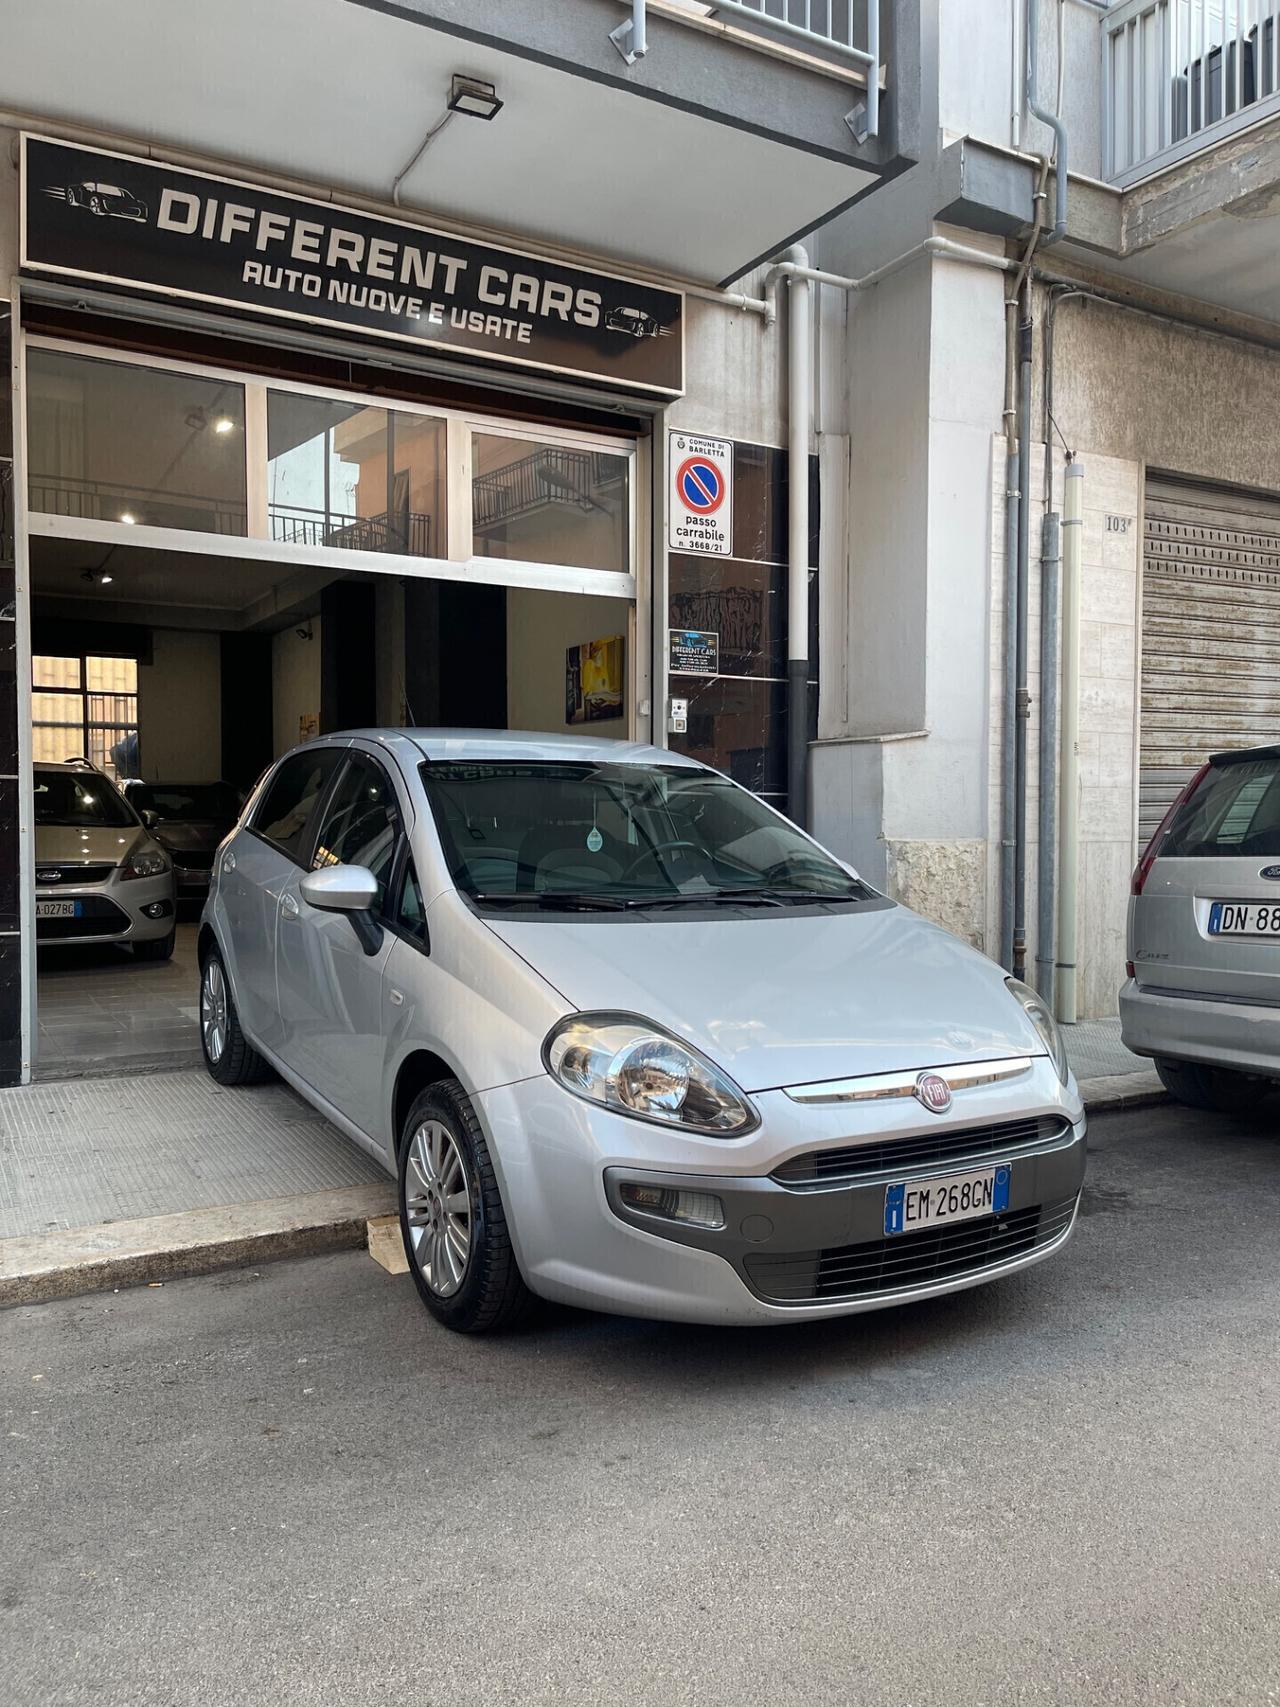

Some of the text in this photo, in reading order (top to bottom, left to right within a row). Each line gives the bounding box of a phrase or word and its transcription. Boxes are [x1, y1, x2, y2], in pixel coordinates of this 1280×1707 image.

[157, 188, 602, 328] DIFFERENT CARS
[242, 260, 533, 344] AUTO NUOVE E USATE
[689, 439, 716, 448] COMUNE
[689, 445, 725, 457] BARLETTA
[686, 516, 717, 527] passo
[676, 528, 725, 541] carrabile
[689, 540, 723, 552] 3668/21
[927, 1083, 946, 1101] FIAT
